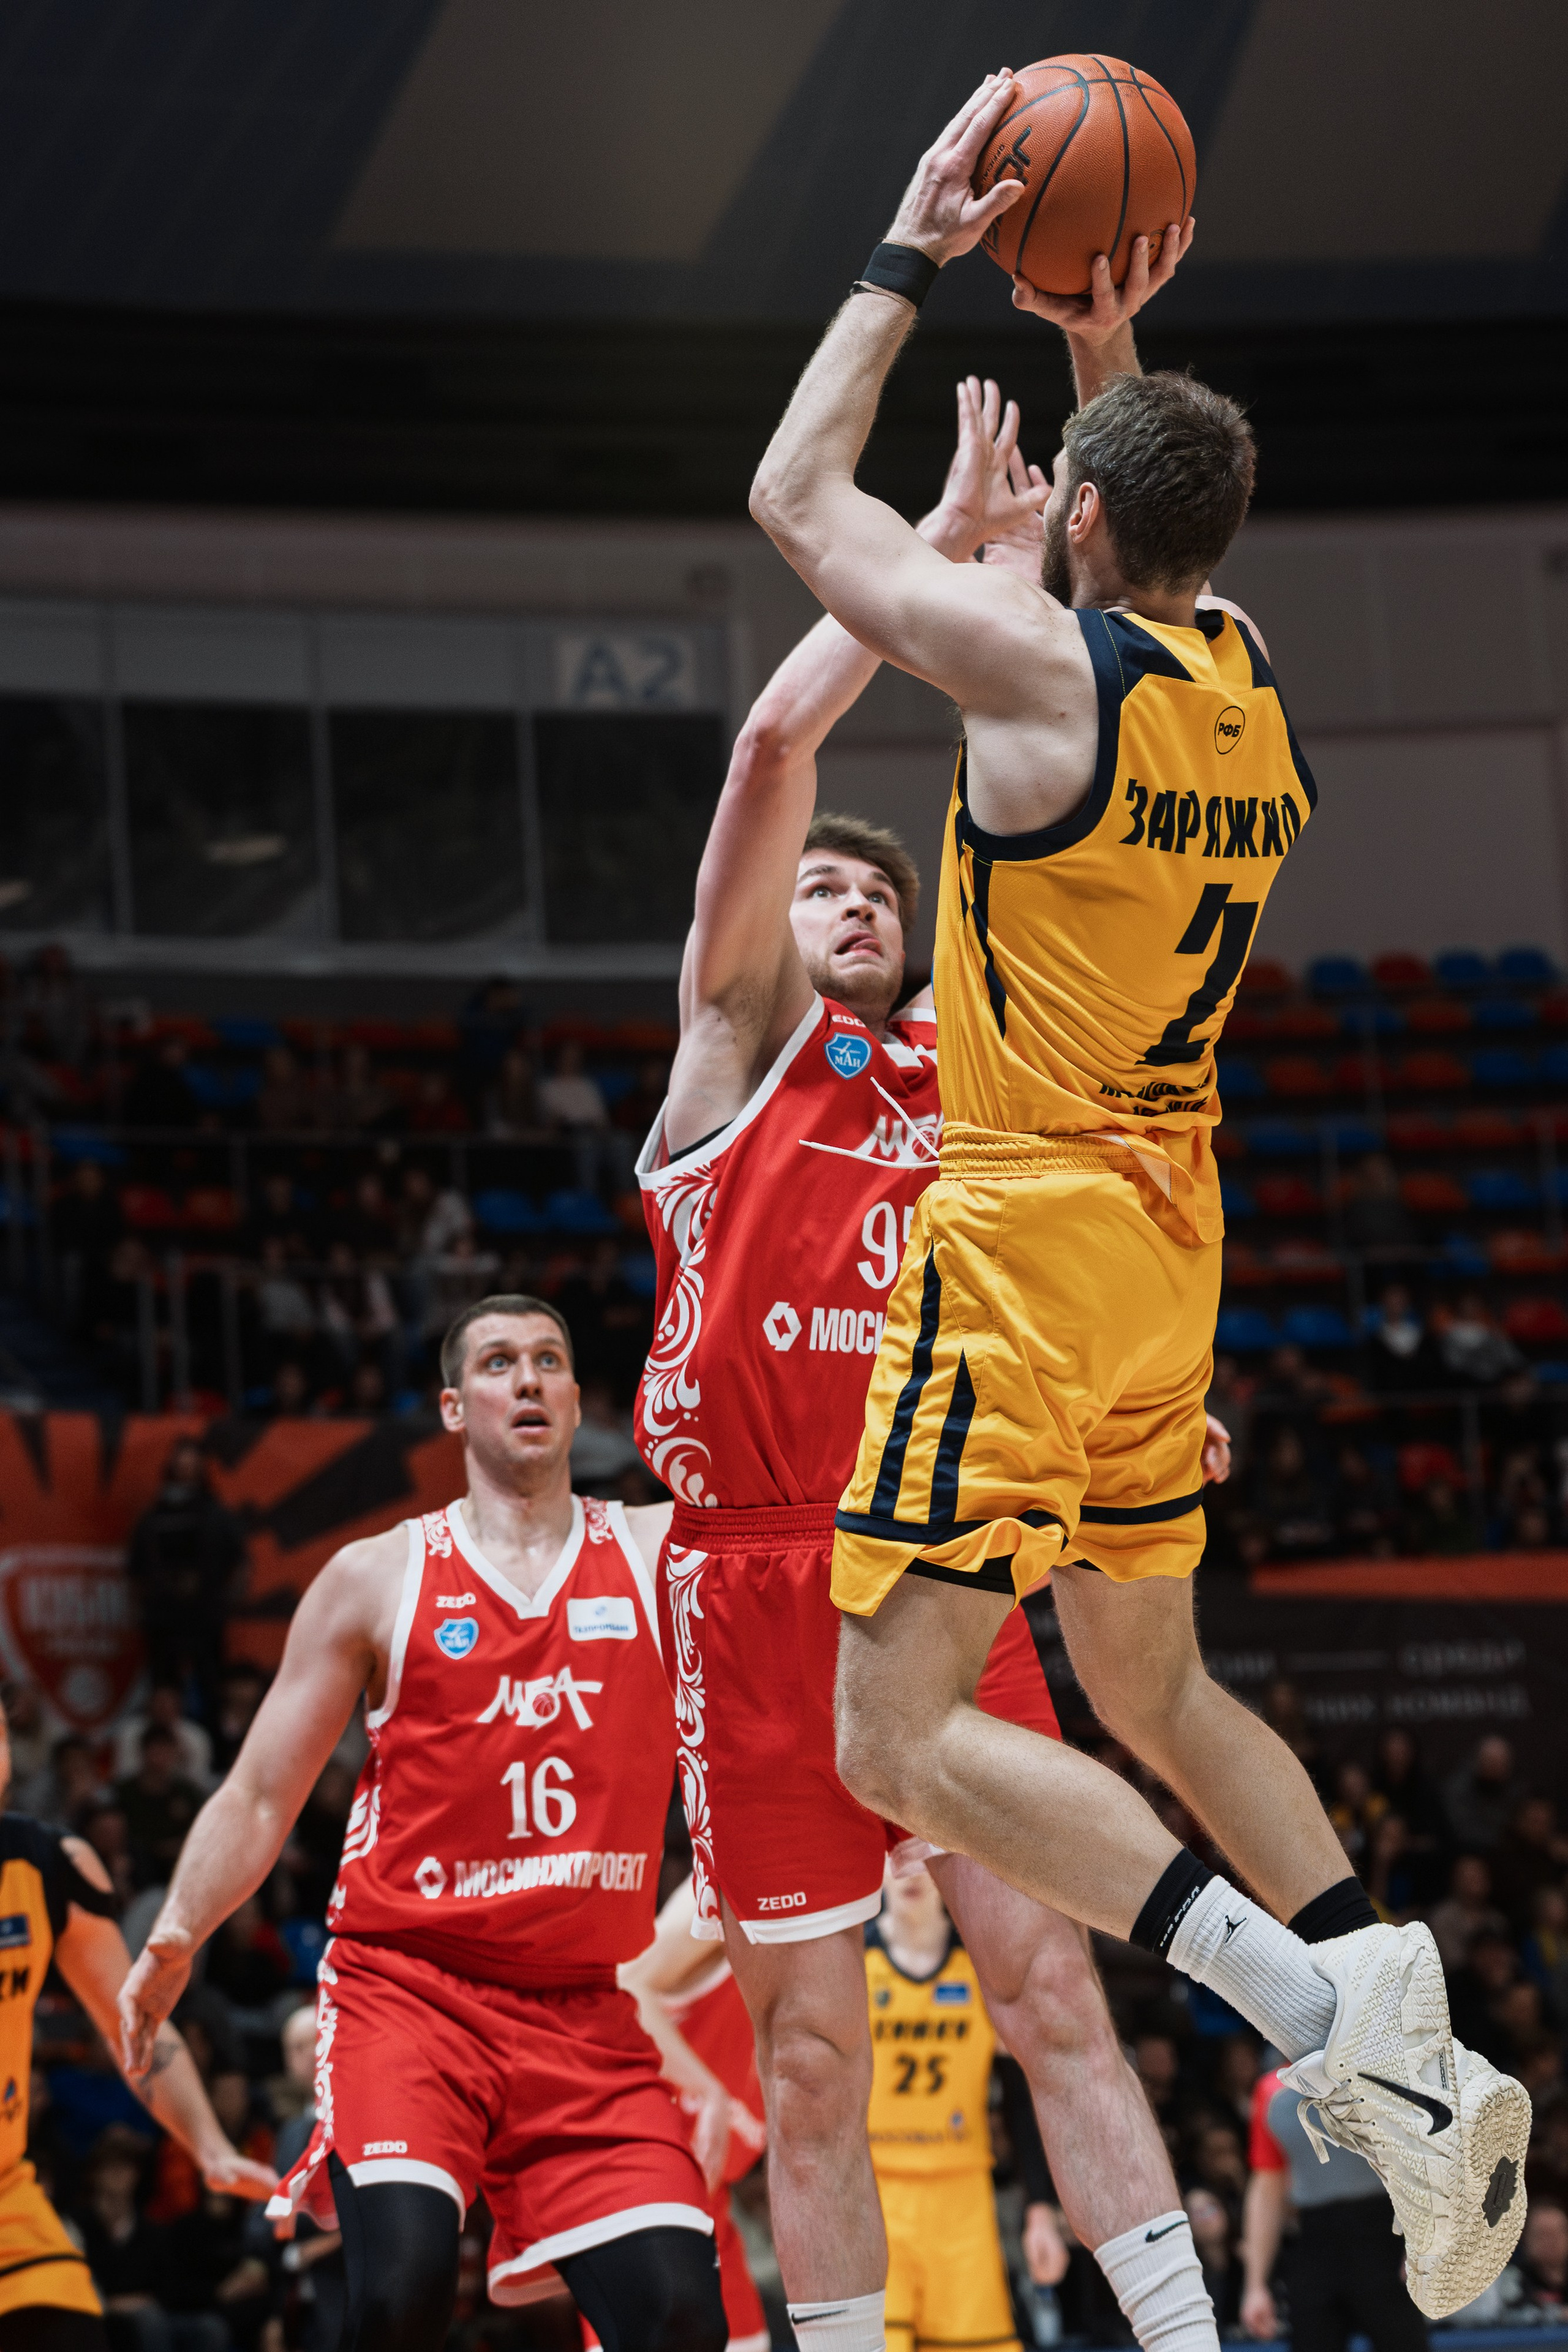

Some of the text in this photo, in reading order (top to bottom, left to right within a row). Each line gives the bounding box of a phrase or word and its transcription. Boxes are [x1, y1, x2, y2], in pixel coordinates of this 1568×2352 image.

[572, 641, 682, 703] A2
[1218, 722, 1241, 738] РФБ
[1118, 778, 1301, 858] ЗАРЯЖКО
[832, 1014, 867, 1028] EDO
[500, 1756, 576, 1839] 16
[757, 1891, 807, 1911] ZEDO
[893, 2053, 949, 2096] 25
